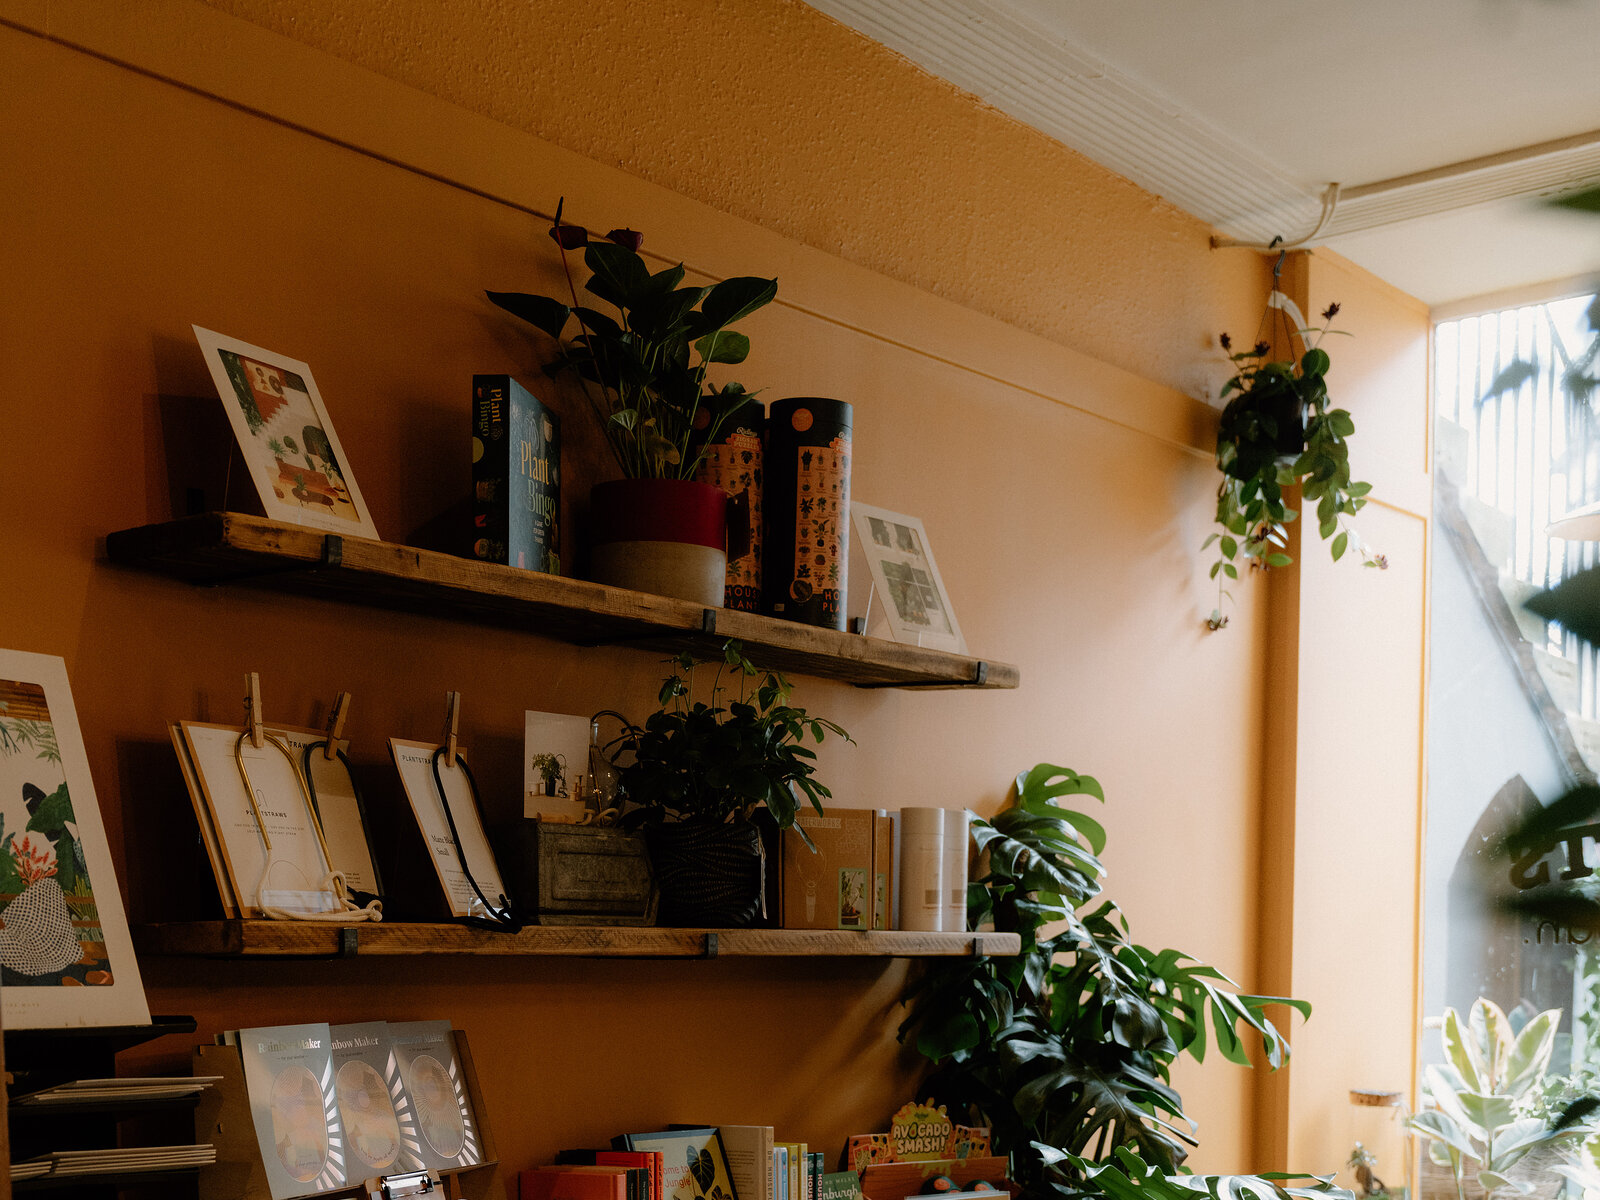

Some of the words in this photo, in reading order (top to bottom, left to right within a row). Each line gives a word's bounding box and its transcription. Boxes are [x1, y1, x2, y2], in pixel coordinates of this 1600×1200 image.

[490, 388, 503, 423] Plant
[479, 401, 491, 437] Bingo
[520, 439, 549, 485] Plant
[528, 479, 556, 527] Bingo
[297, 1038, 321, 1050] Maker
[331, 1039, 353, 1051] nbow
[353, 1036, 379, 1049] Maker
[893, 1121, 950, 1139] AVOCADO
[896, 1136, 946, 1155] SMASH!
[665, 1175, 691, 1188] Jungle
[823, 1184, 858, 1200] nburgh
